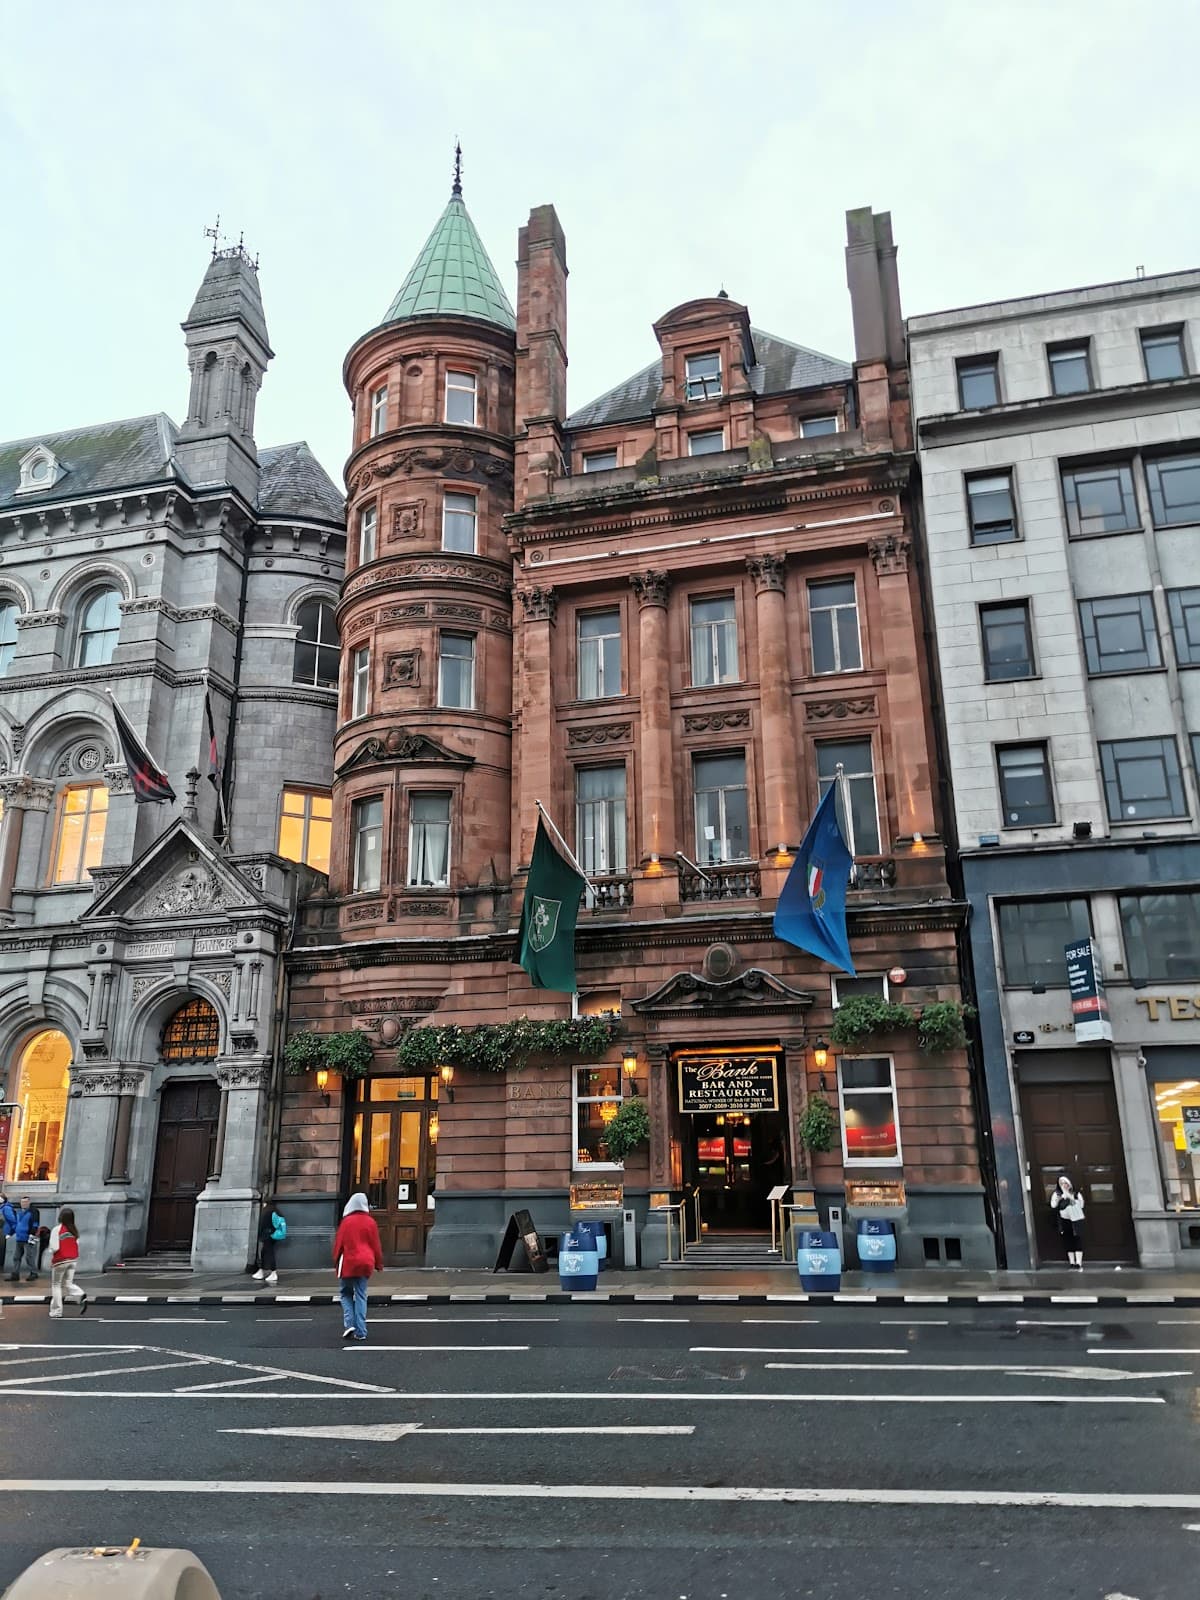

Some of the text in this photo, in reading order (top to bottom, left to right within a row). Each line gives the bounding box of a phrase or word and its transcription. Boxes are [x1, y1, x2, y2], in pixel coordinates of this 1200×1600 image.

[1066, 945, 1092, 960] FOR SALE
[696, 1061, 758, 1081] Bank
[510, 1083, 568, 1099] BANK
[702, 1080, 753, 1089] BAR AND
[689, 1088, 767, 1098] RESTAURANT
